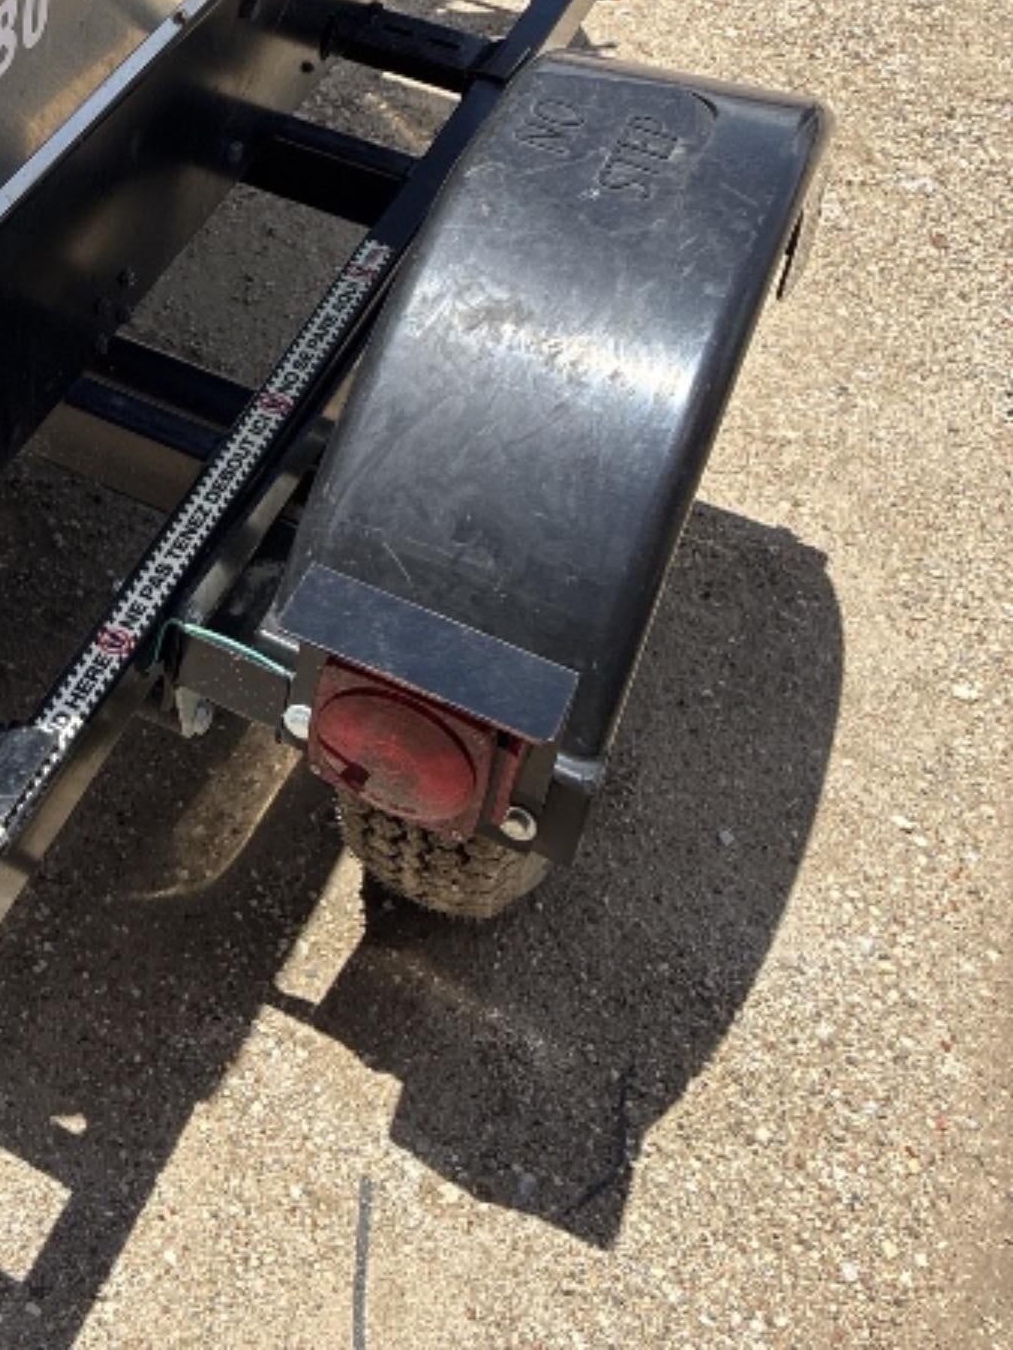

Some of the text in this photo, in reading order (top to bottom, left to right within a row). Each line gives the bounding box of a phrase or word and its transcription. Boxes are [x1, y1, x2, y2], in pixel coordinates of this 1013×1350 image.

[513, 98, 585, 155] NO
[598, 115, 678, 200] STEP
[120, 601, 148, 630] NE
[140, 563, 174, 601] PAS
[165, 504, 212, 560] TENEZ
[204, 434, 255, 504] DEBOUT
[70, 653, 112, 709] HERE
